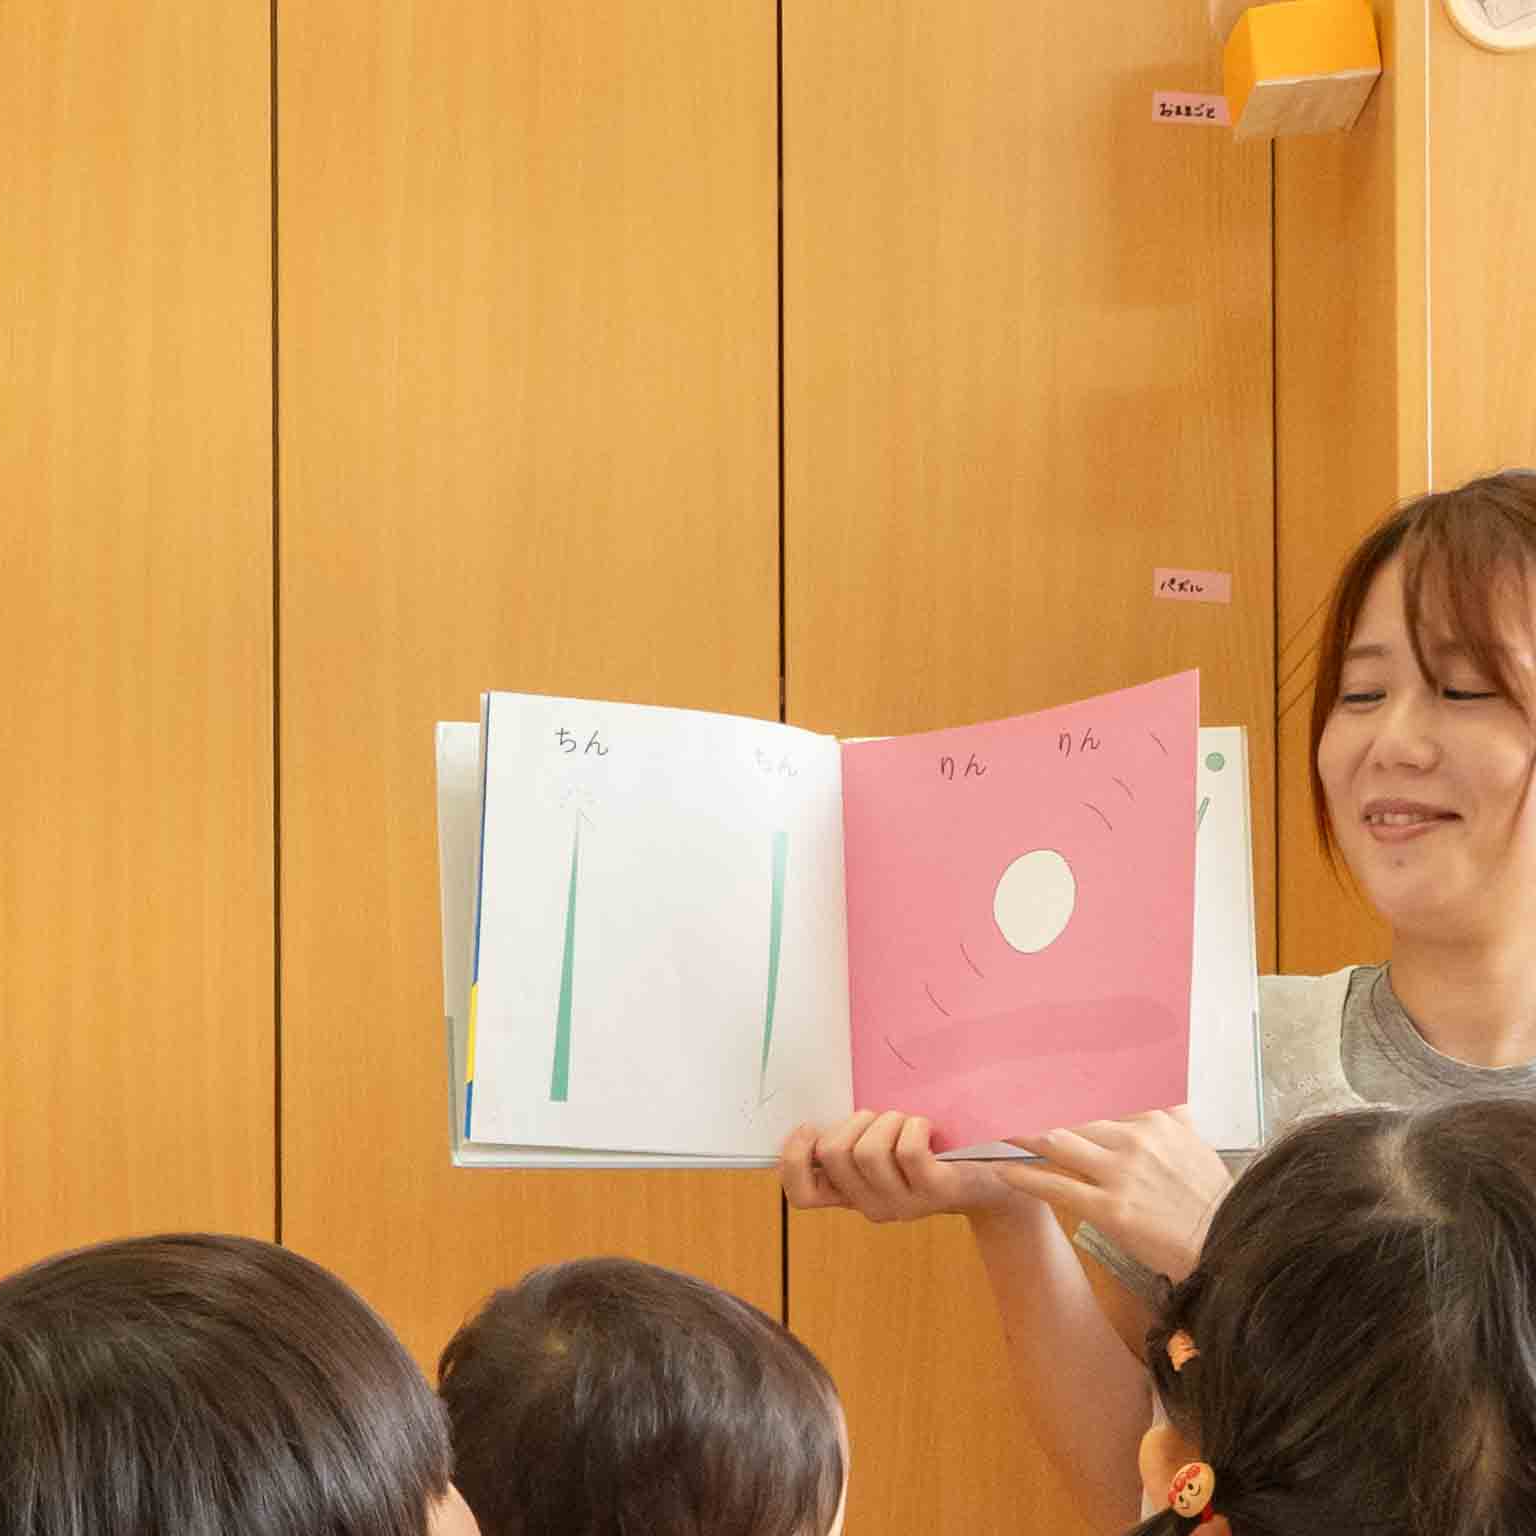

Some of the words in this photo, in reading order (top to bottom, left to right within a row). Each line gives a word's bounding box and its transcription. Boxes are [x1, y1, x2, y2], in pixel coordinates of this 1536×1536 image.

[1159, 101, 1216, 119] おままごと
[554, 727, 609, 756] ちん
[940, 753, 987, 781] りん
[1058, 727, 1102, 758] りん
